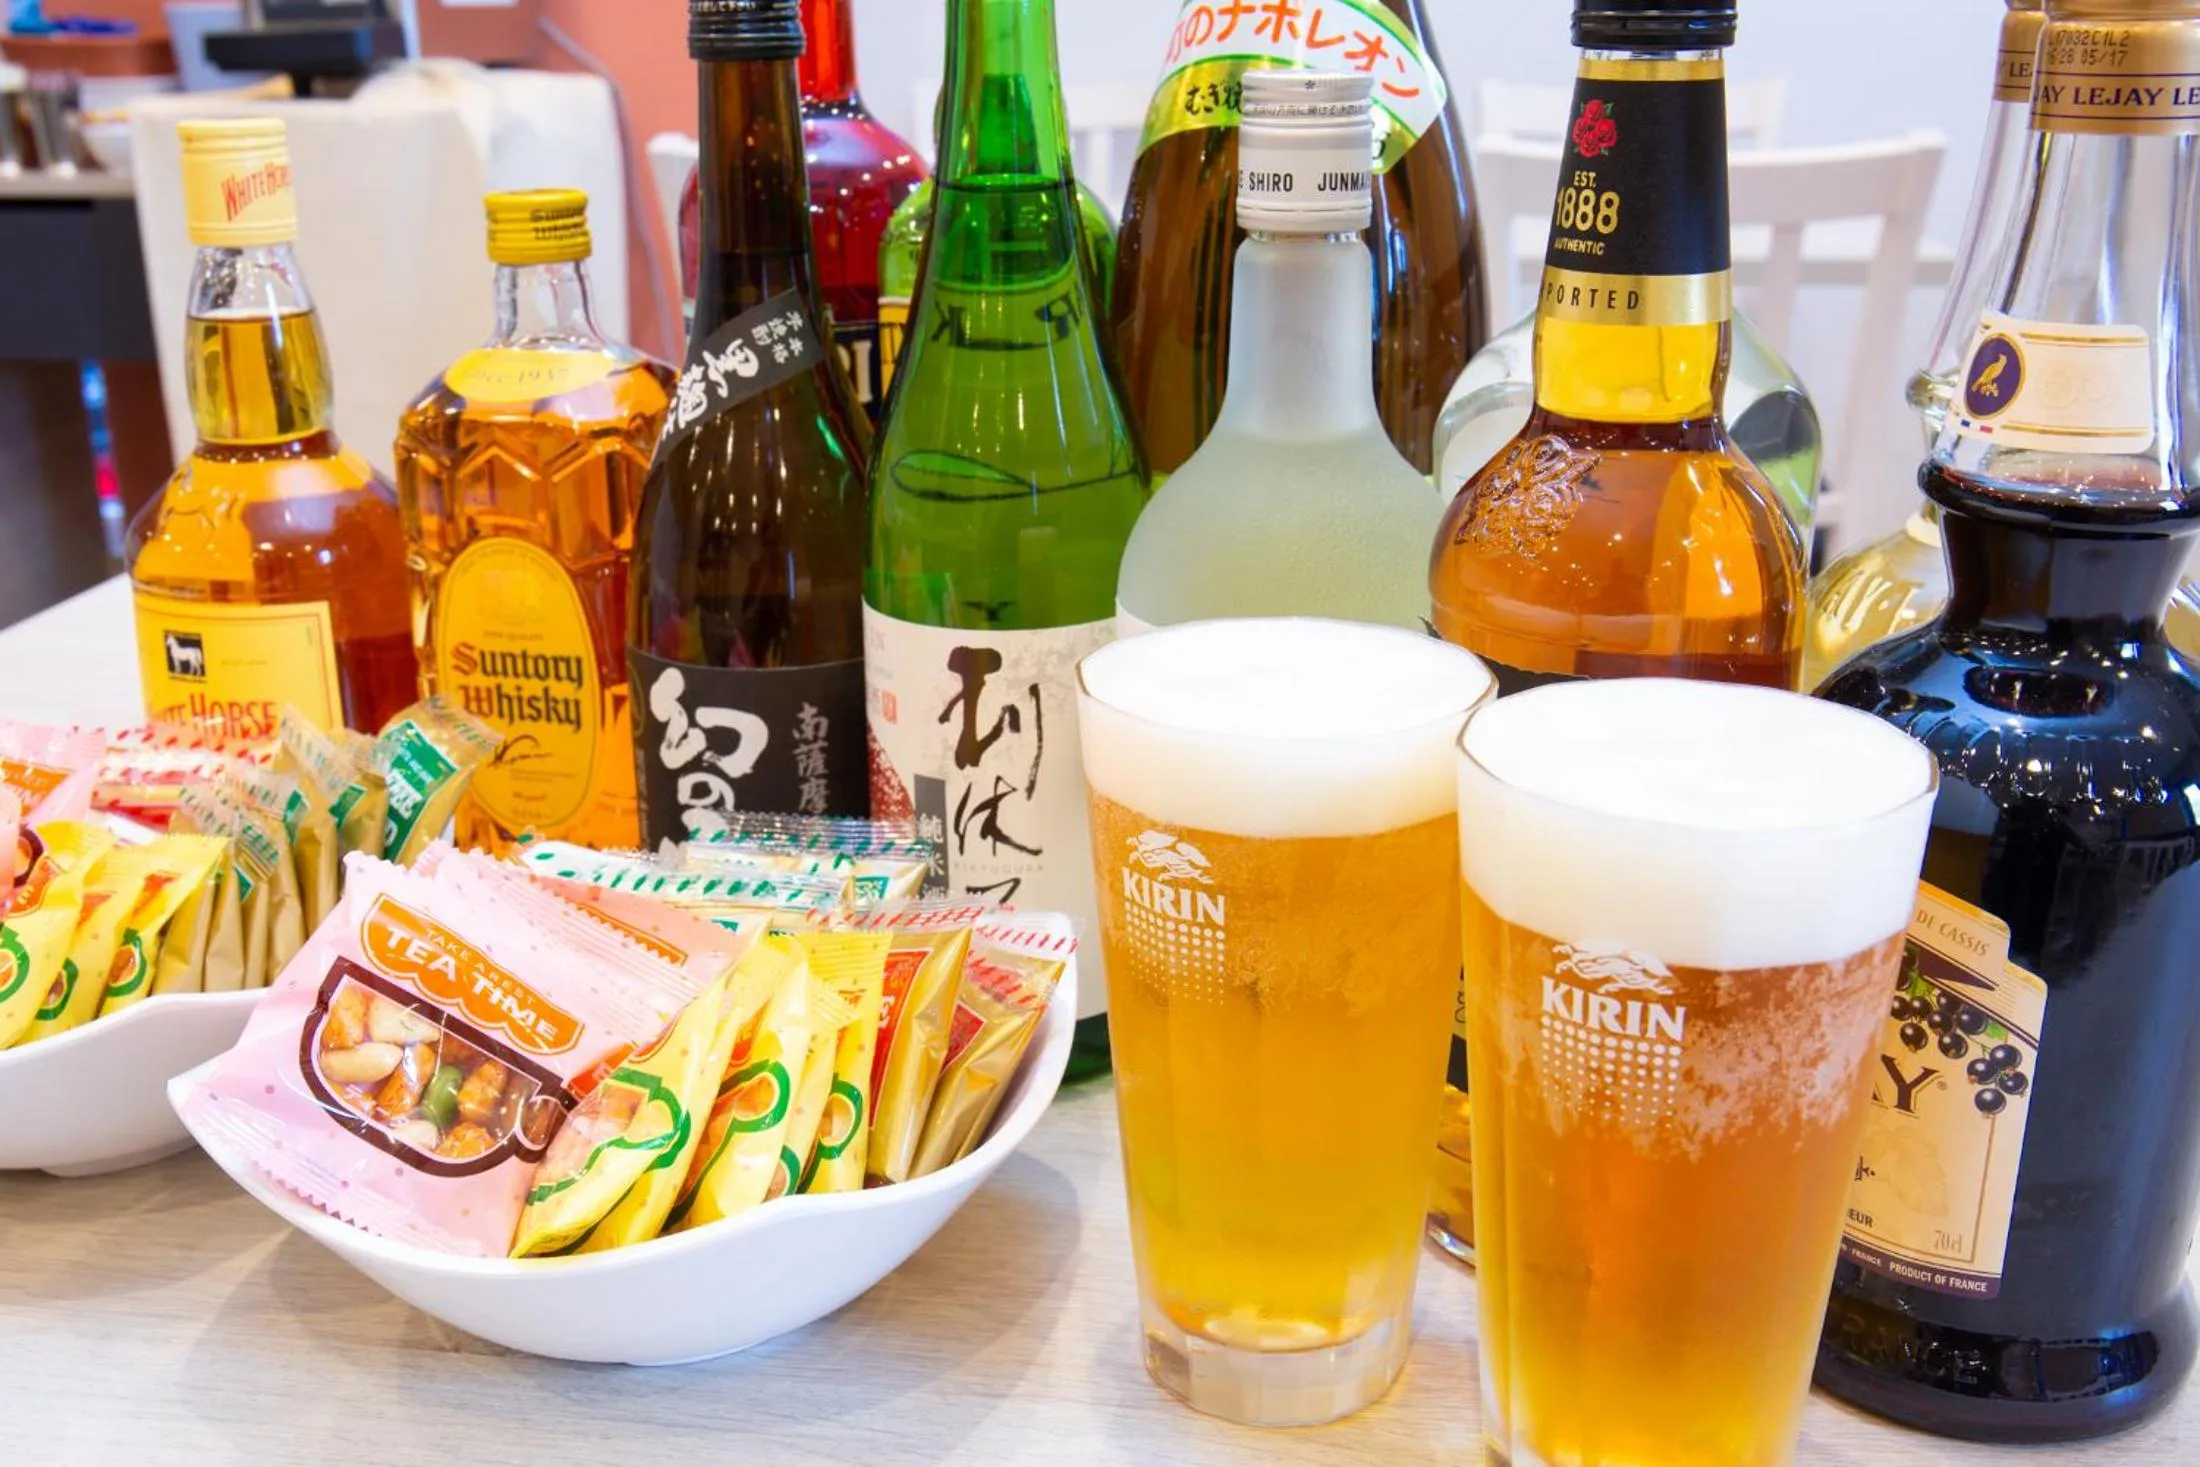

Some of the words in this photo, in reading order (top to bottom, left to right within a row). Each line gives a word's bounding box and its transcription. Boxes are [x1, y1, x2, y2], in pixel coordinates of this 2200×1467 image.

[2072, 87, 2164, 106] LEJAY
[1249, 172, 1293, 192] SHIRO
[1317, 172, 1367, 191] JUNMA
[1573, 170, 1597, 188] EST.
[1556, 187, 1620, 234] 1888
[1554, 239, 1605, 255] AUTHENTIC
[452, 642, 583, 689] Suntory
[458, 684, 582, 733] Whisky
[792, 702, 829, 815] 南薩摩
[1122, 866, 1225, 926] KIRIN
[426, 928, 471, 962] TAKE
[1939, 923, 1992, 956] CASSIS
[385, 926, 457, 983] TEA
[471, 971, 559, 1042] TIME
[1541, 975, 1686, 1042] KIRIN
[1889, 1261, 1932, 1283] PRODUCT
[1935, 1274, 1947, 1285] OF
[1950, 1277, 1988, 1293] FRANCE
